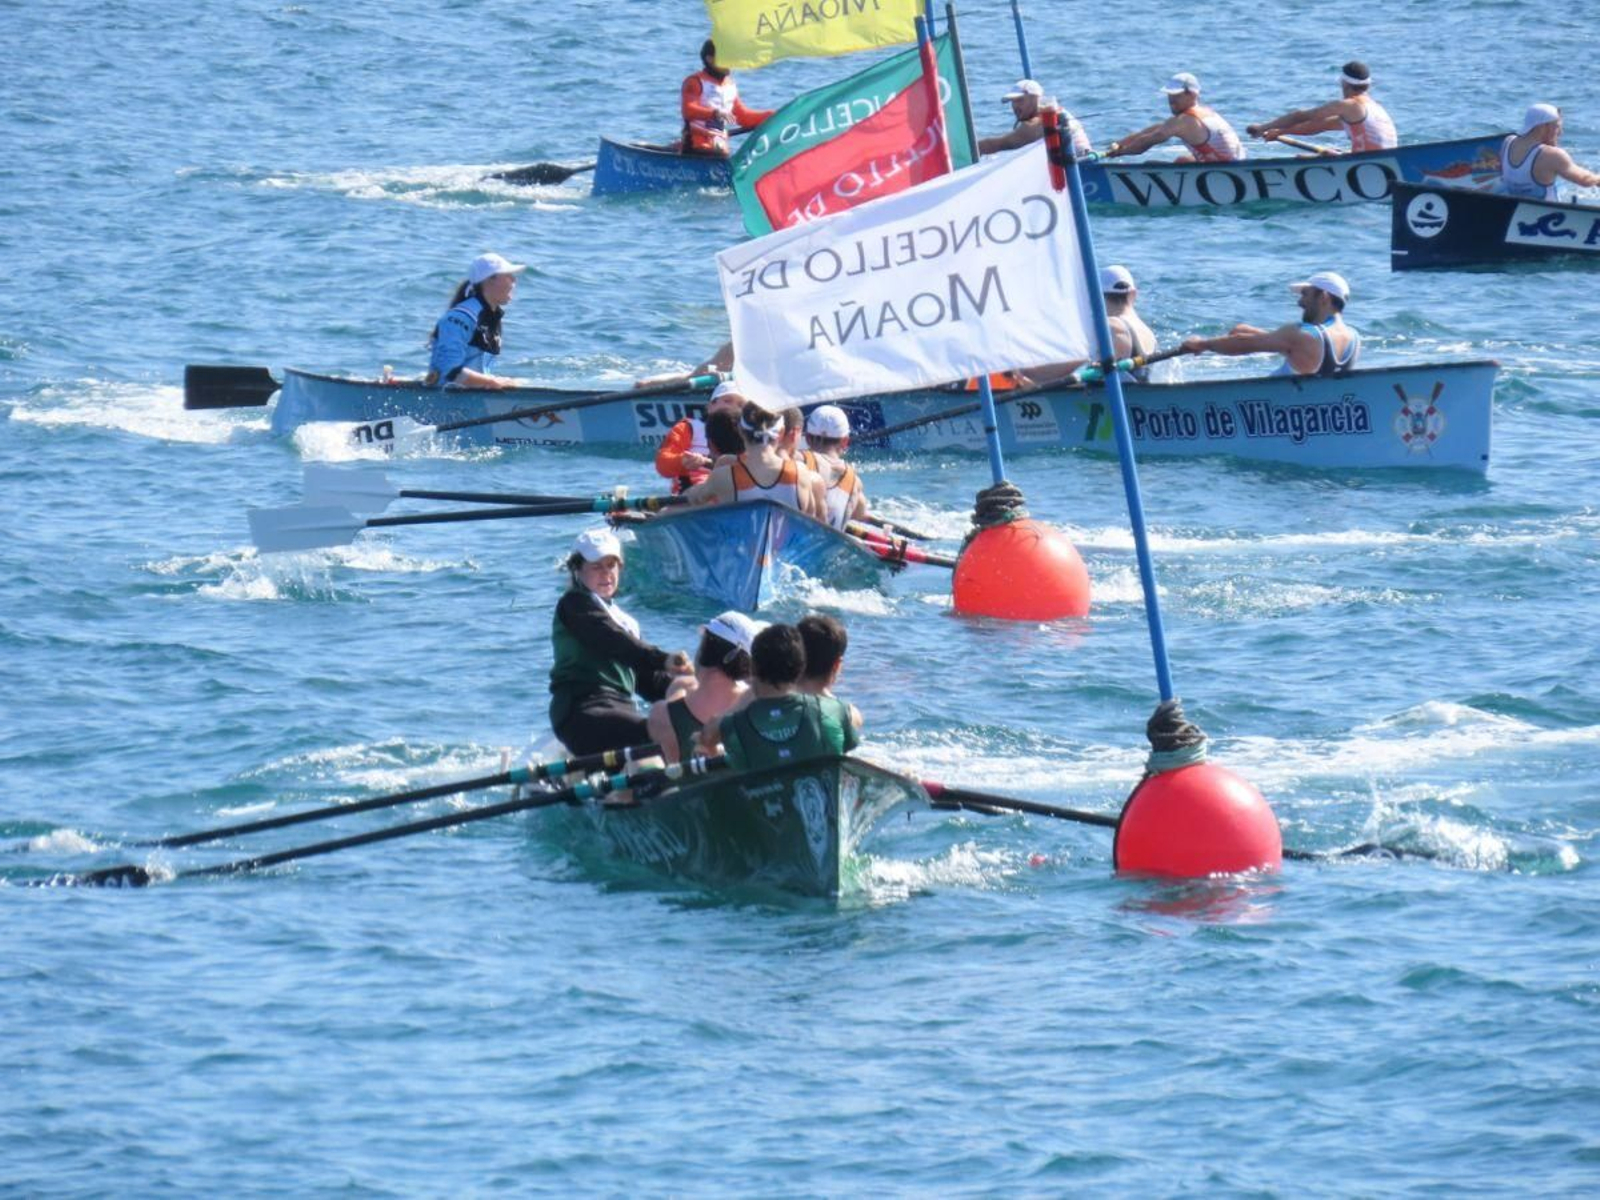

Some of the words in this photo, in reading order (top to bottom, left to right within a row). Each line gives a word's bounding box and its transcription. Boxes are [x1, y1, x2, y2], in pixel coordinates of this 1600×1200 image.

[1111, 162, 1398, 207] WOFCO
[1130, 404, 1199, 440] Porto
[1204, 402, 1236, 439] de
[1236, 395, 1374, 444] Vilagarcía
